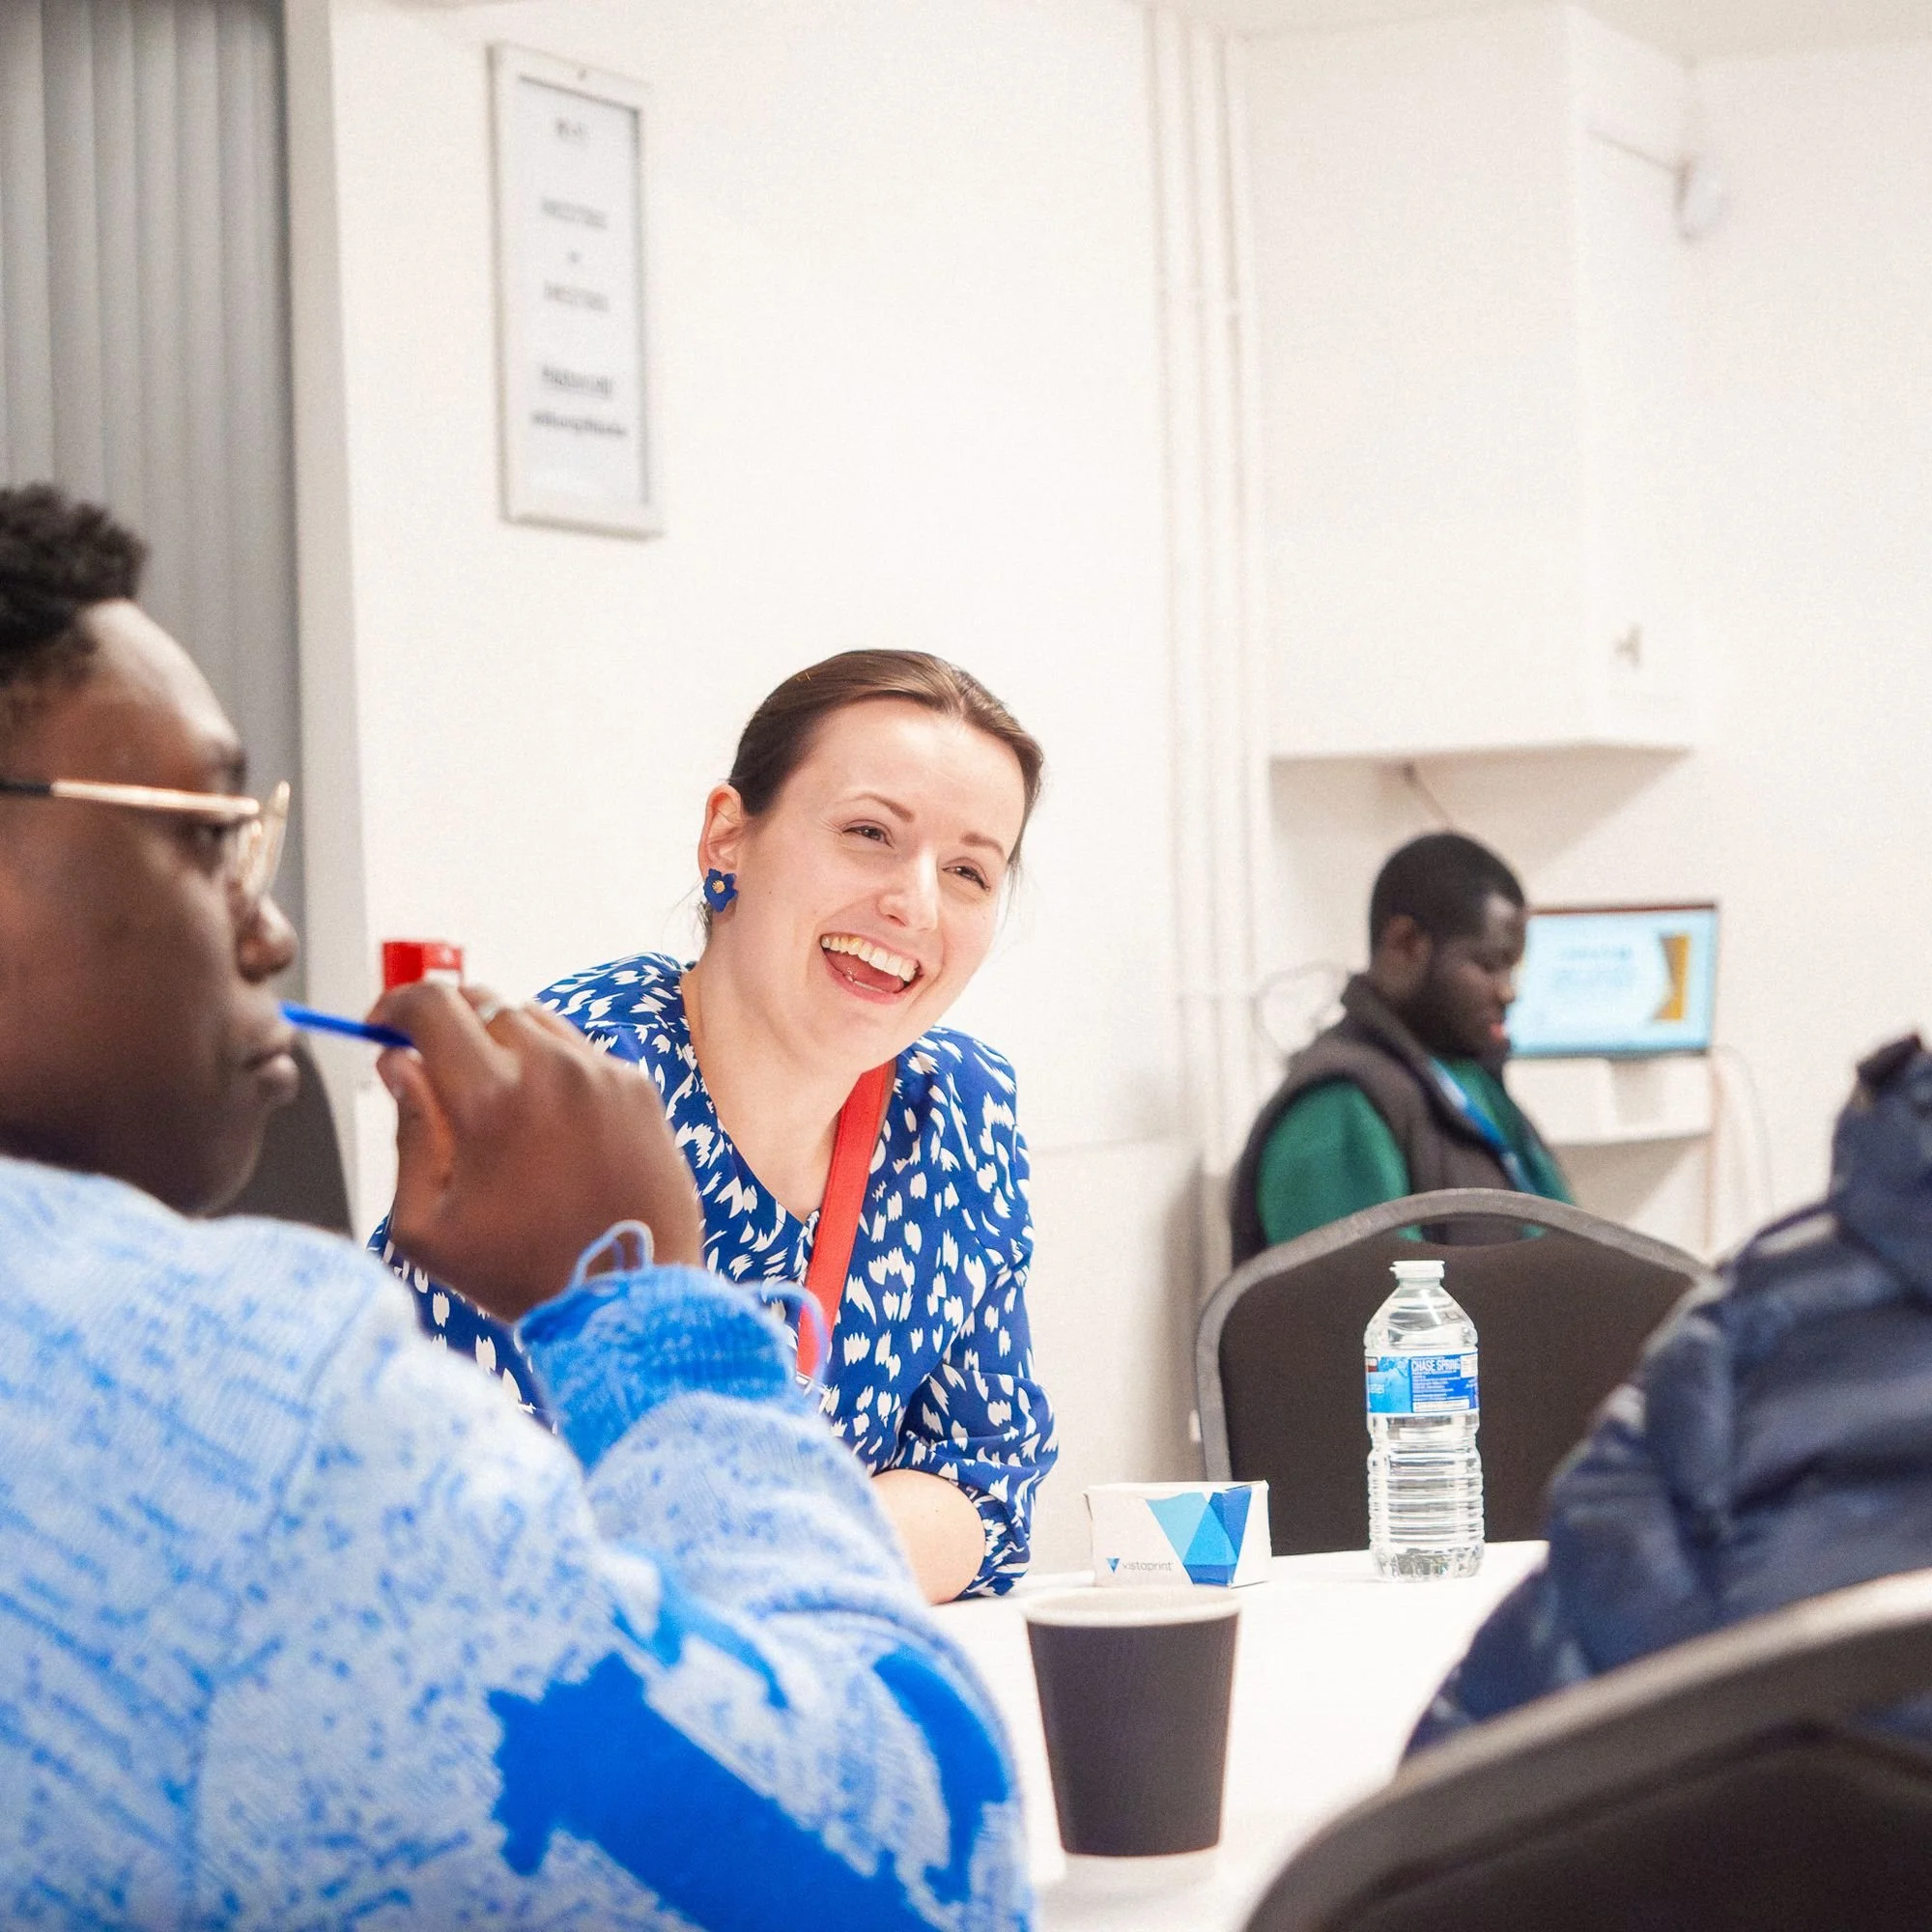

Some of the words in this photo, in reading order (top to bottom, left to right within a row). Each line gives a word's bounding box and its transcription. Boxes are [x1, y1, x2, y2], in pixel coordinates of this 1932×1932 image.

[1411, 1359, 1436, 1372] CHASE
[1437, 1358, 1461, 1371] SPRING
[1122, 1561, 1172, 1573] vistaprint
